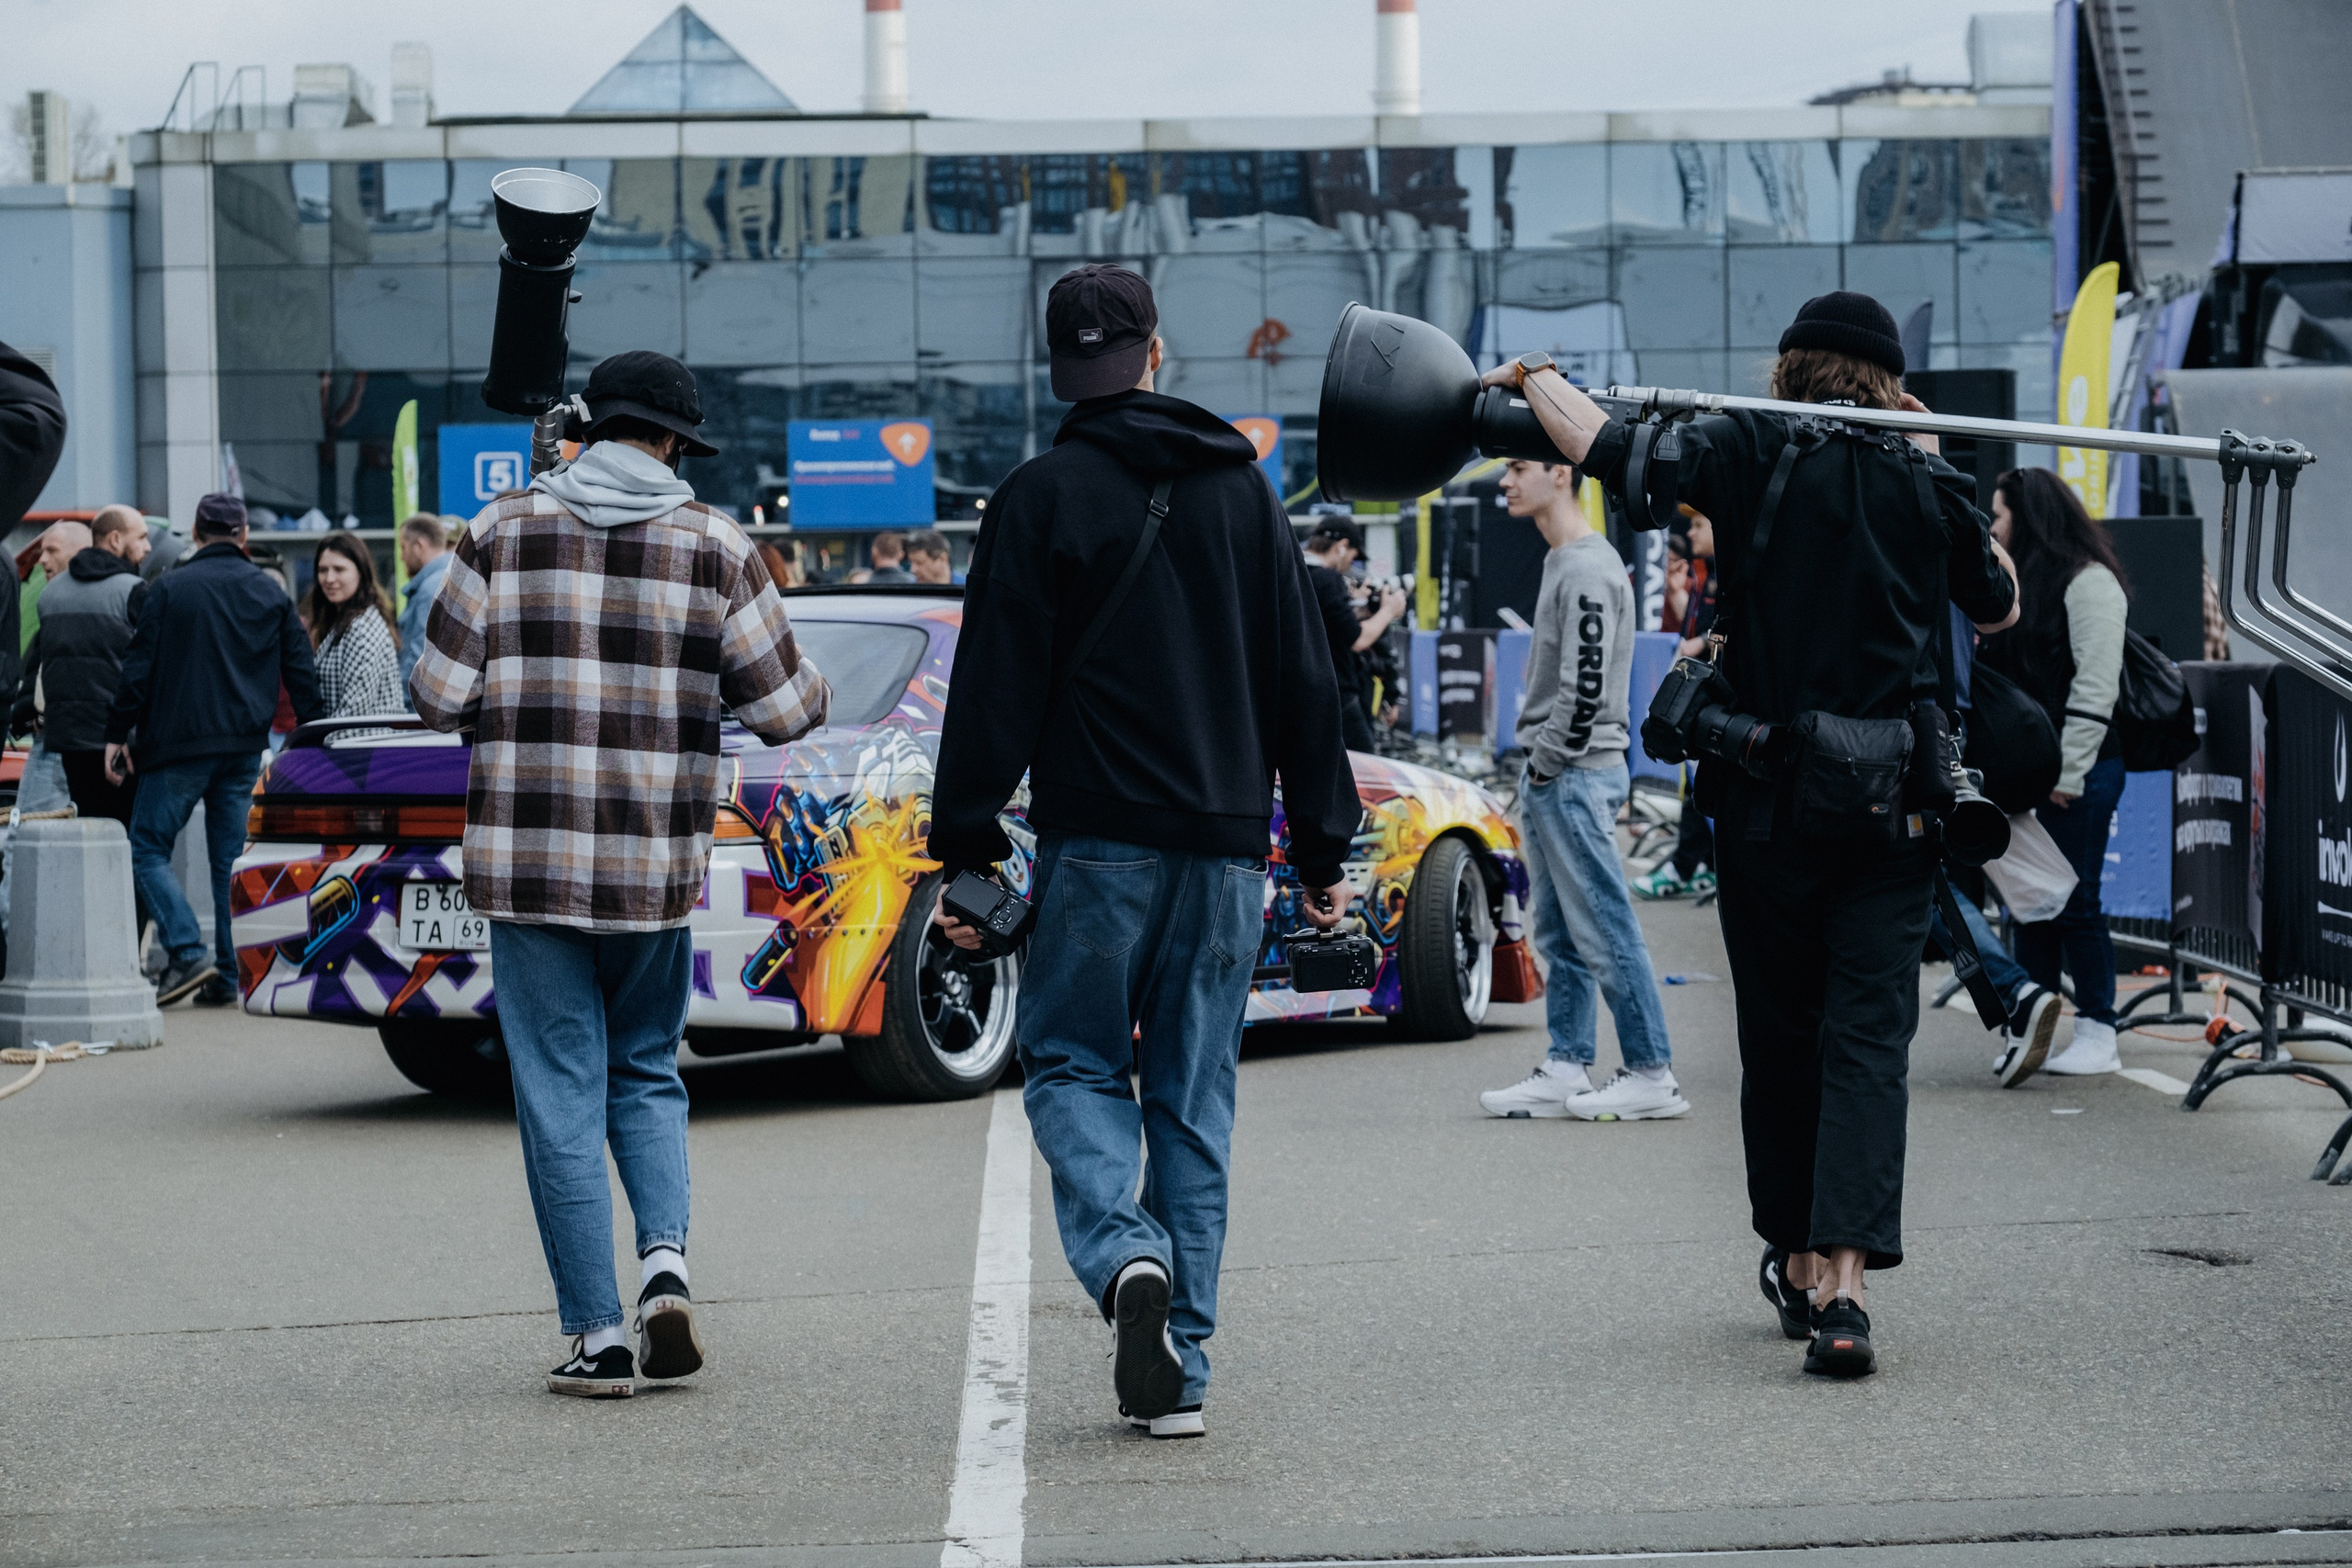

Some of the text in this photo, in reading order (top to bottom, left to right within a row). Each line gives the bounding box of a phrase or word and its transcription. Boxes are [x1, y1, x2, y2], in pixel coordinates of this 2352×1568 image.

[488, 460, 513, 492] 5
[1565, 593, 1603, 751] JORDAN
[415, 887, 472, 911] B 60
[413, 919, 484, 943] TA 69
